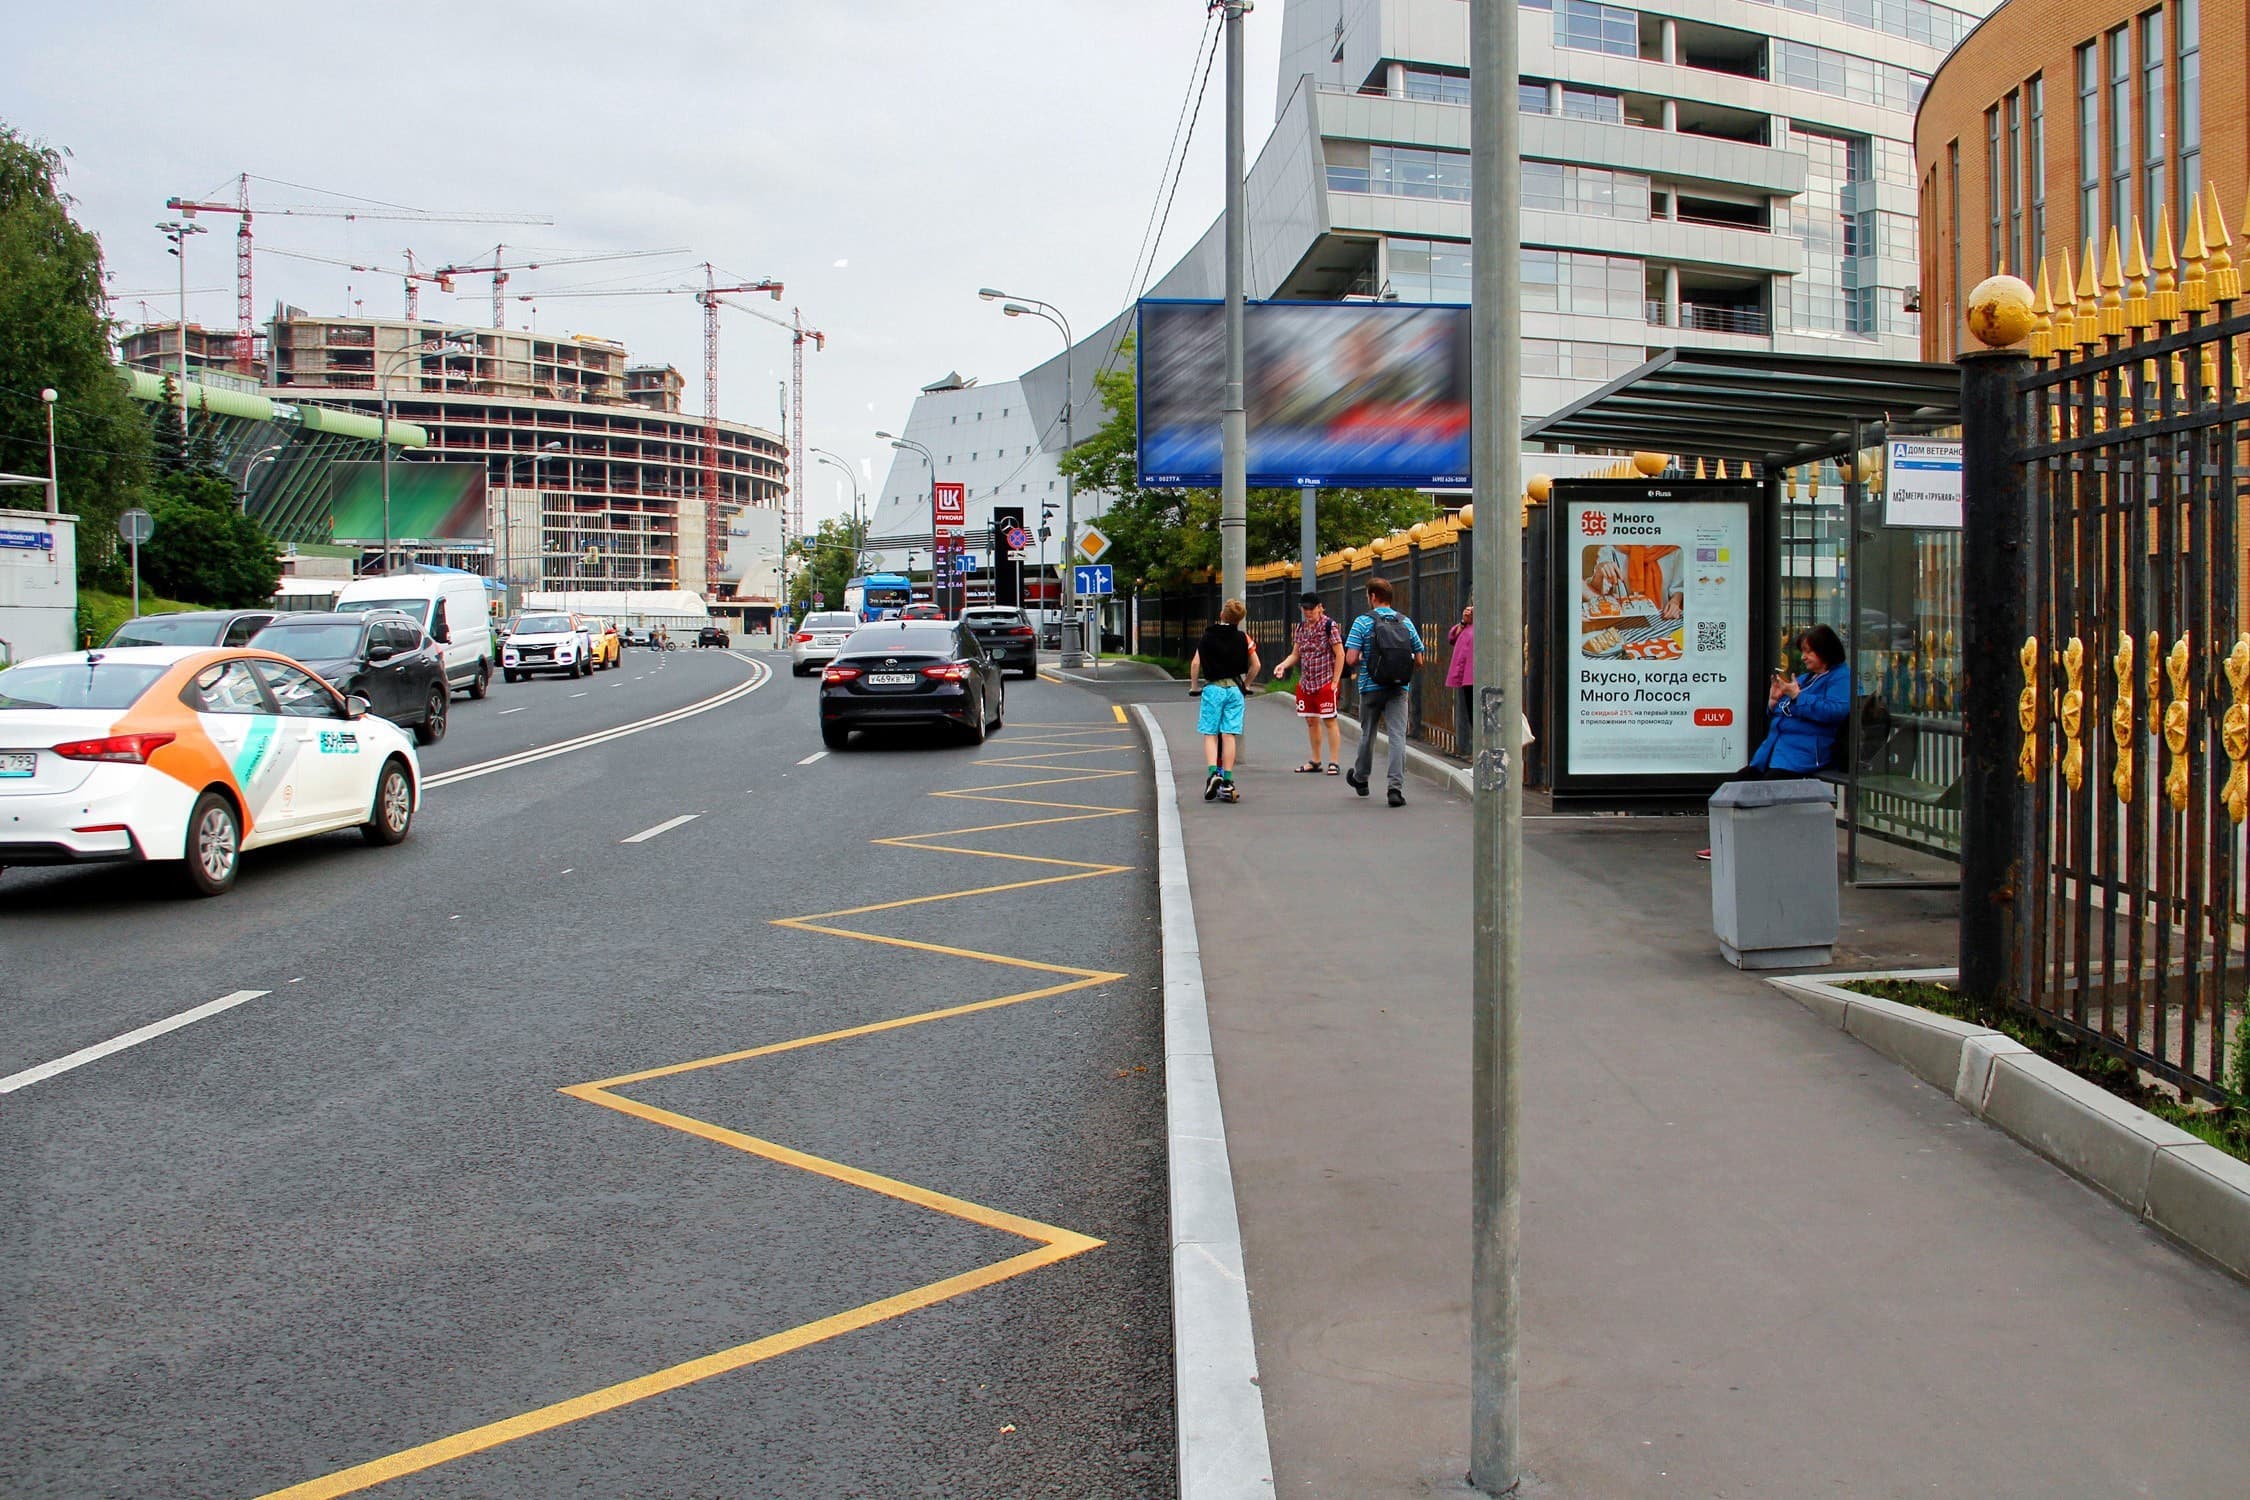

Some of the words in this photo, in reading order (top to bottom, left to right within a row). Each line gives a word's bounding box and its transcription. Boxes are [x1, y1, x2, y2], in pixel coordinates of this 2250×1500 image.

[1895, 444, 1906, 457] А
[1908, 446, 1925, 454] ДОМ
[1906, 492, 1924, 500] МЕТРО
[1925, 493, 1955, 502] «ТРУБНАЯ»
[1612, 512, 1655, 524] Много
[1612, 525, 1661, 535] лосося
[1580, 670, 1641, 686] Вкусно,
[1645, 672, 1688, 685] когда
[1692, 672, 1727, 683] есть
[1580, 689, 1630, 702] Много
[1634, 689, 1690, 702] Лосося
[1591, 709, 1619, 717] скидкой
[1643, 709, 1669, 717] первый
[1702, 713, 1725, 722] JULY
